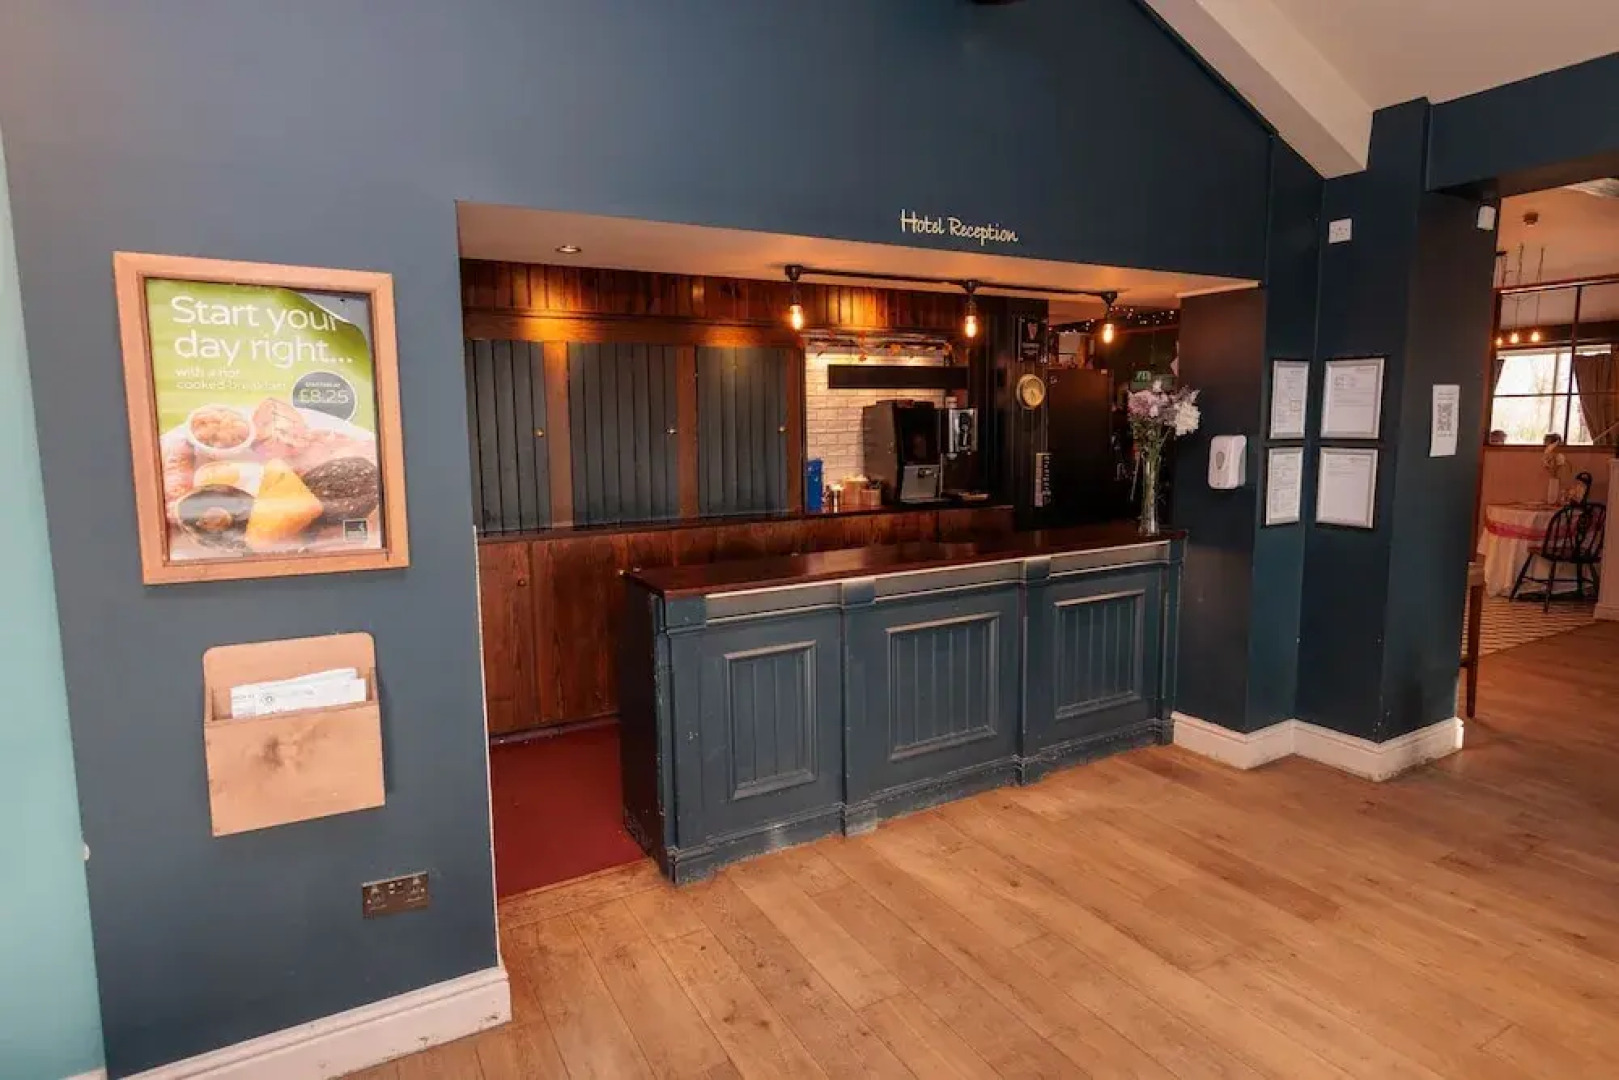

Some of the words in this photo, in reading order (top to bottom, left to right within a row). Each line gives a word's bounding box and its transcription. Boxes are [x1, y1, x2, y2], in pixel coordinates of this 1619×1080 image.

[900, 208, 945, 234] Hotel
[947, 216, 1019, 247] Reception
[171, 295, 260, 327] Start
[266, 308, 337, 336] your
[174, 329, 241, 366] day
[250, 334, 353, 369] right...
